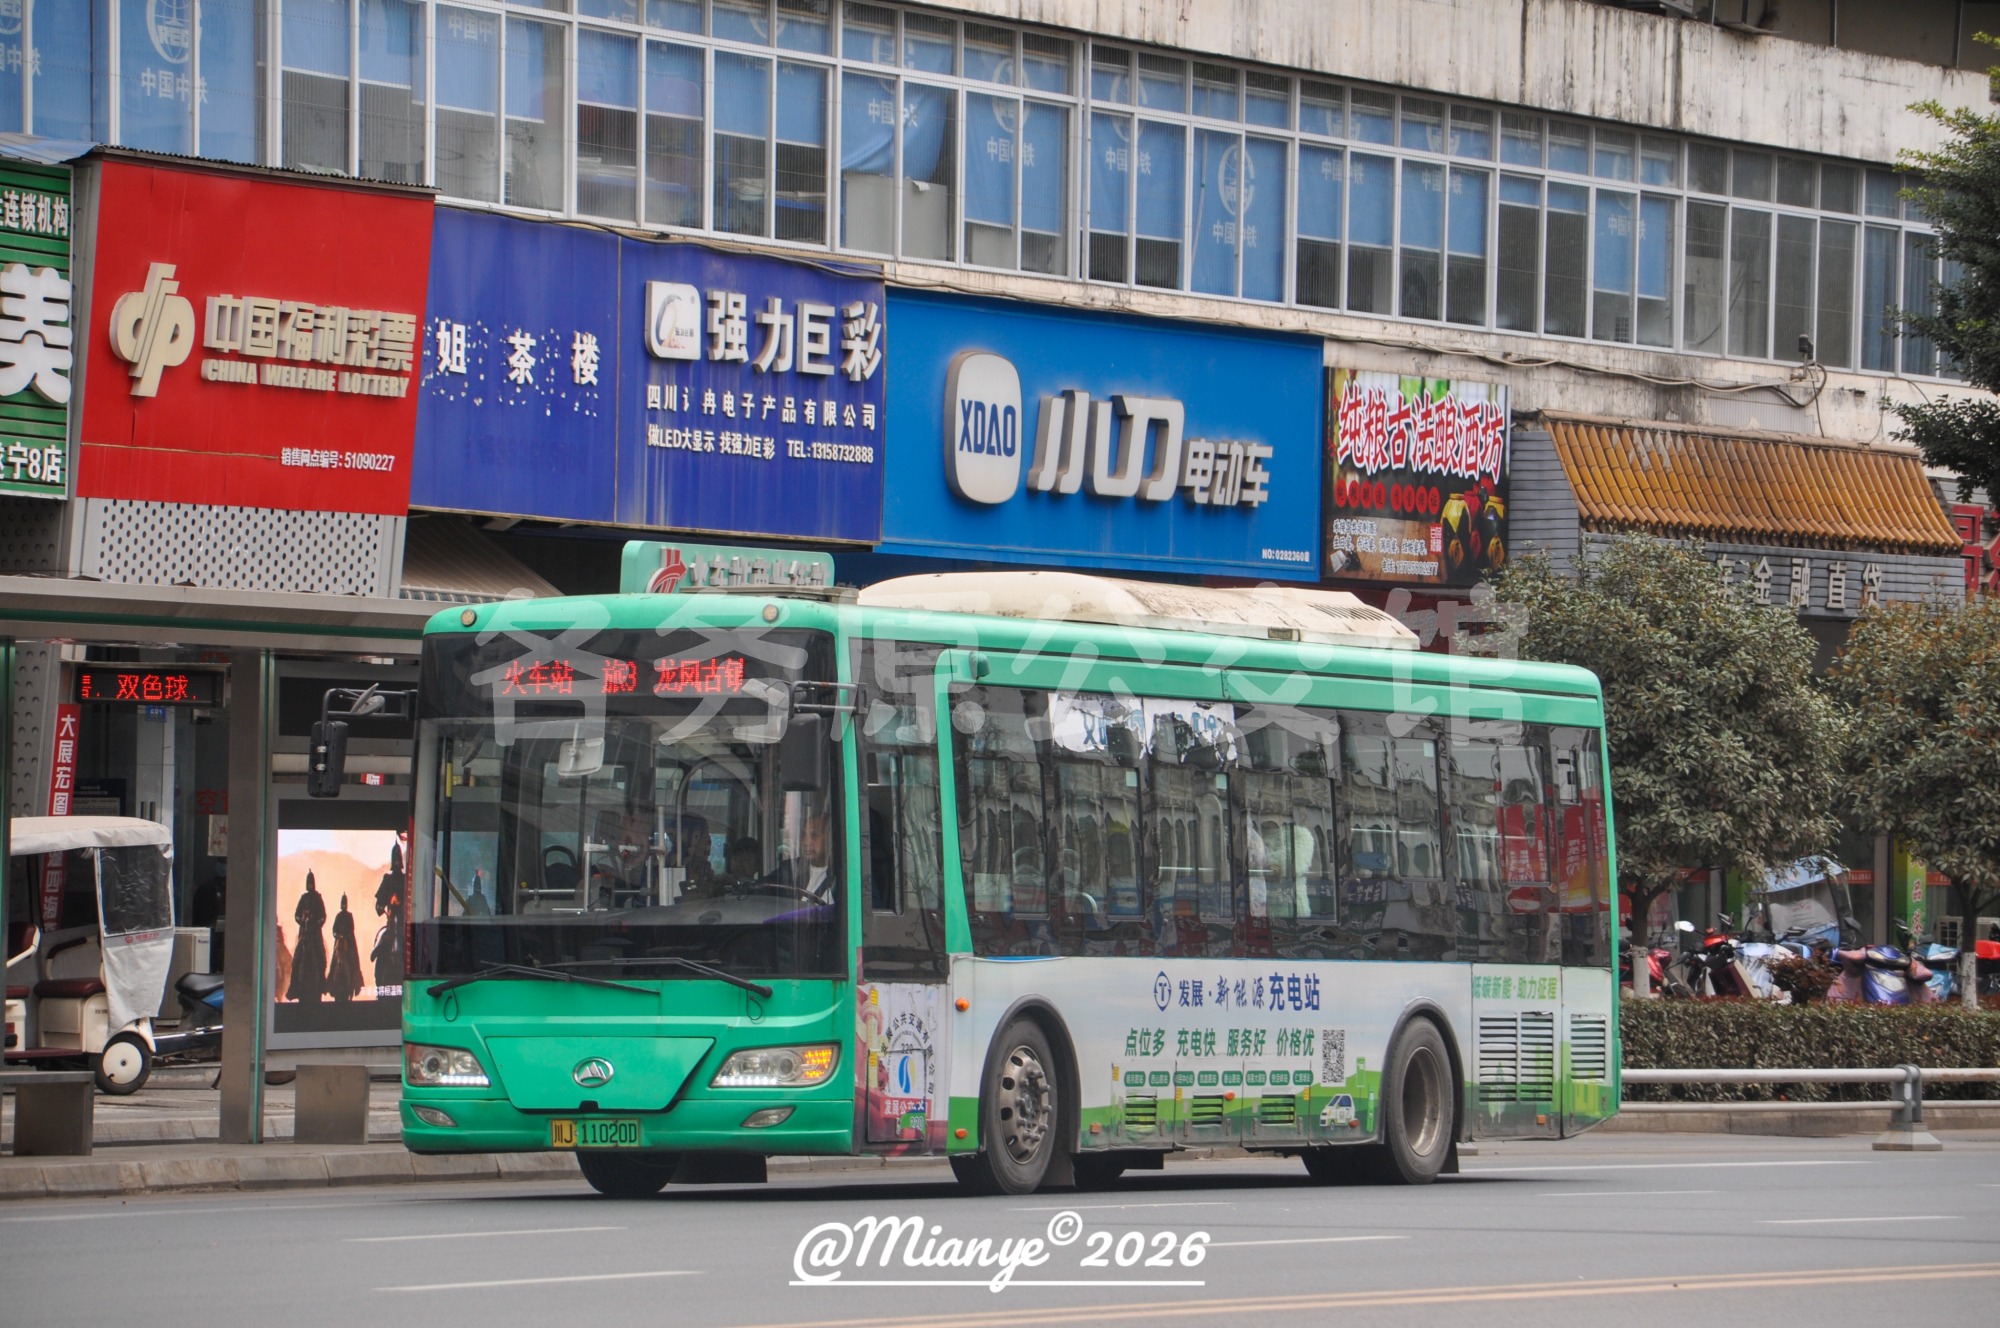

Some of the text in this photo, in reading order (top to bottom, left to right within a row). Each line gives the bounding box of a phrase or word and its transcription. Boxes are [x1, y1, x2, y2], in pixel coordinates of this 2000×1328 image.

[987, 136, 1035, 167] 中国铁
[1105, 147, 1152, 176] 中国铁
[1322, 157, 1365, 184] 中国铁
[1421, 169, 1463, 195] 中国铁
[0, 190, 69, 236] 连锁机构
[204, 294, 417, 372] 中国福利彩票
[706, 290, 882, 382] 强力巨彩
[201, 358, 411, 398] CHINA WELFARE LOTTERY
[0, 441, 63, 483] 宁8店
[719, 430, 776, 460] 找强力巨彩
[1027, 388, 1274, 508] 小刀 电动车
[502, 660, 574, 695] 火车站
[52, 713, 77, 816] 大展宏图
[1124, 1027, 1316, 1057] 点位多 充电快 服务好 价格优
